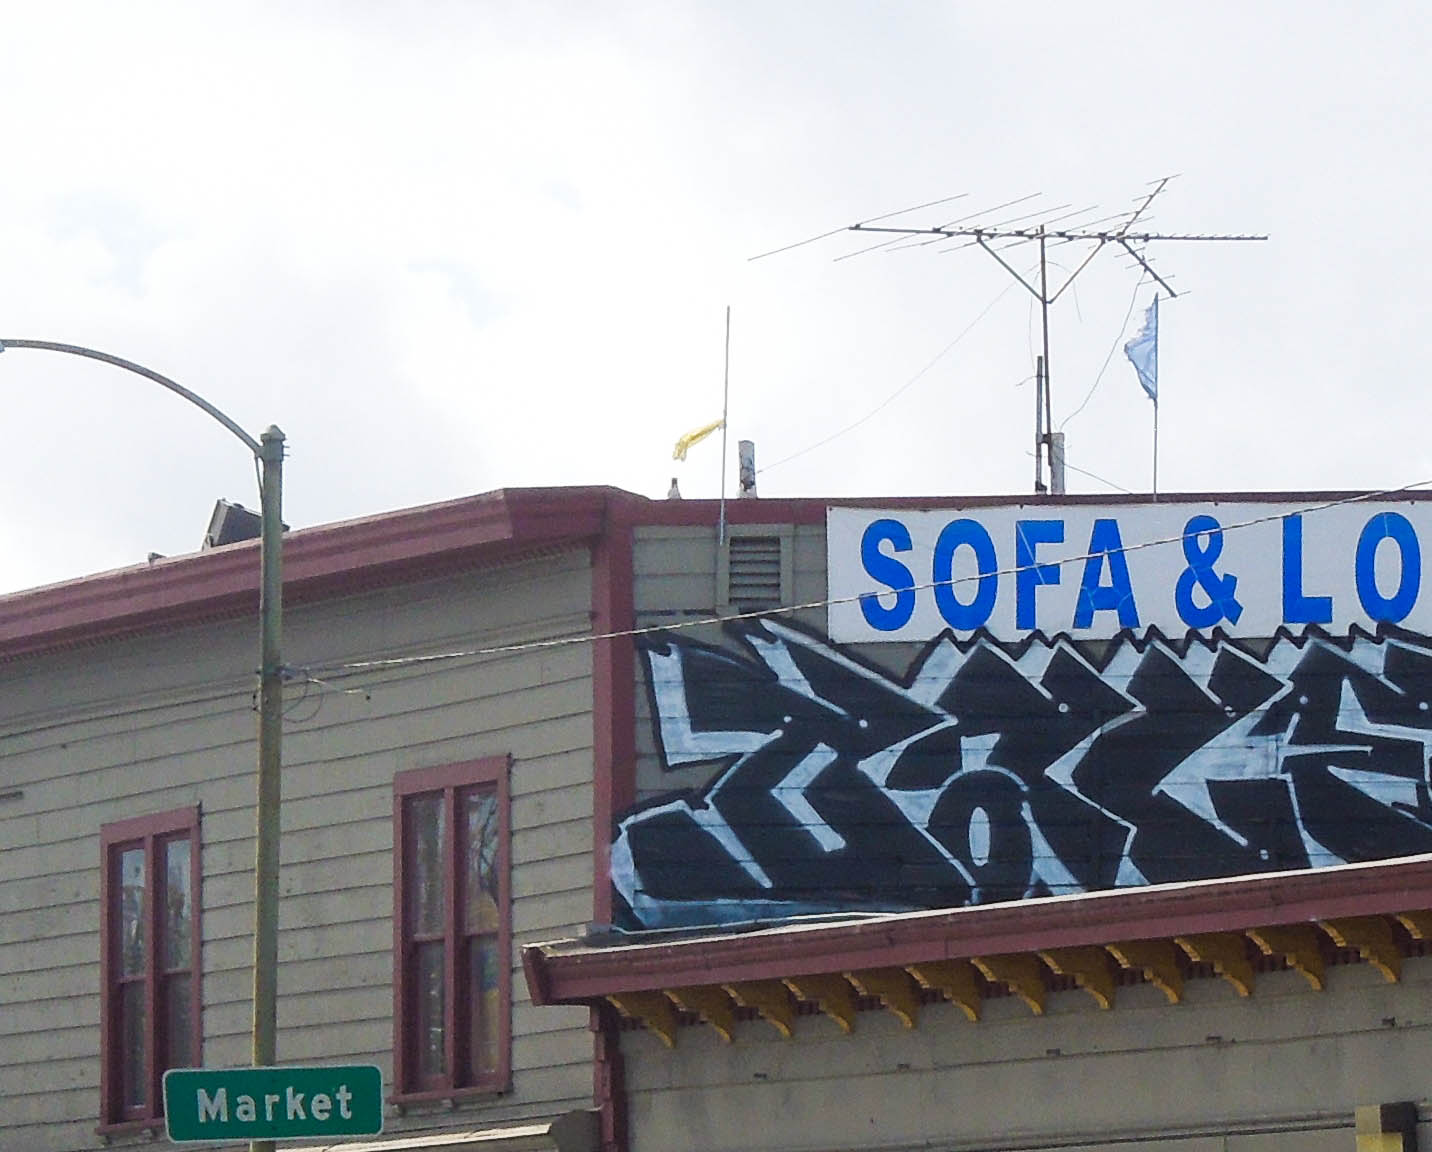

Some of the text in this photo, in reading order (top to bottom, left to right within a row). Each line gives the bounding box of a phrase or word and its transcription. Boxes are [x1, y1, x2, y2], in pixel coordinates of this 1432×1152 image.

[858, 516, 1142, 633] SOFA
[1173, 513, 1245, 630] &
[196, 1084, 354, 1123] Market
